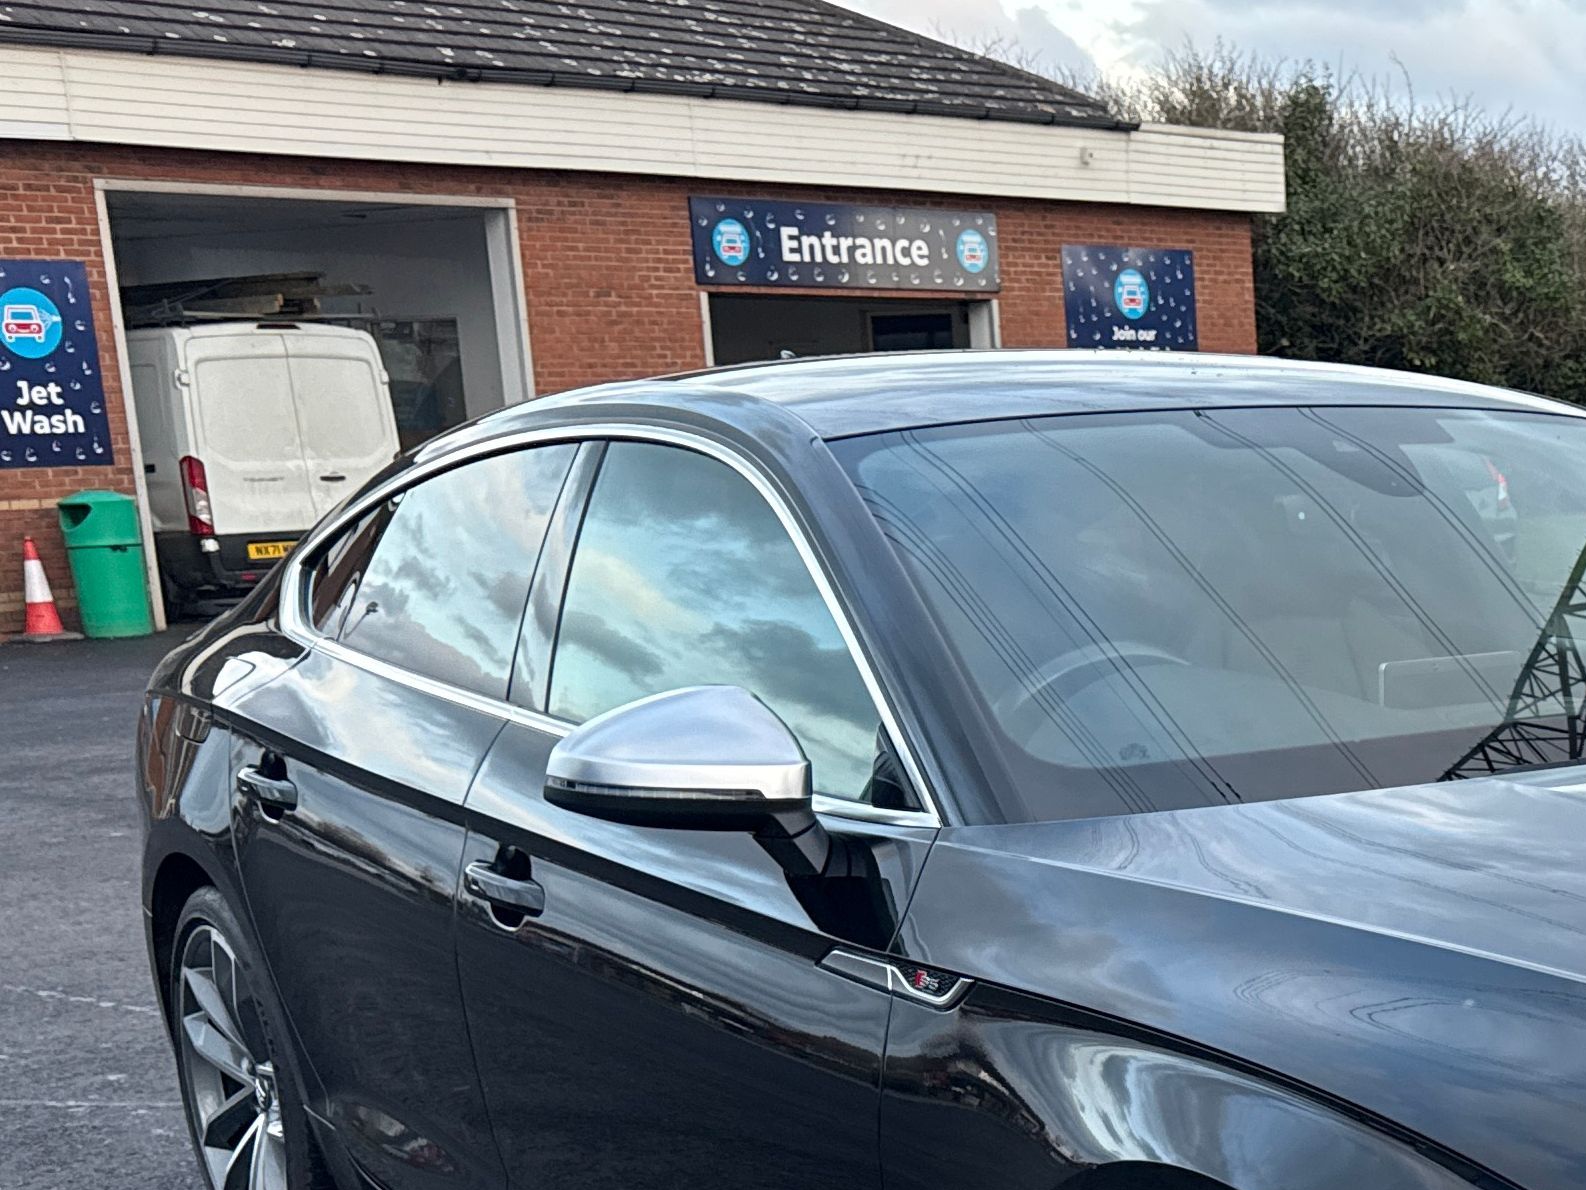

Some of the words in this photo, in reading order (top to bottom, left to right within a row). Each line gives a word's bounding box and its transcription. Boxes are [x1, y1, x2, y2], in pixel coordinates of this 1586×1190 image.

[779, 226, 930, 266] Entrance
[1112, 325, 1136, 341] Join
[1137, 329, 1157, 341] our
[16, 380, 65, 406] Jet
[0, 408, 86, 434] Wash
